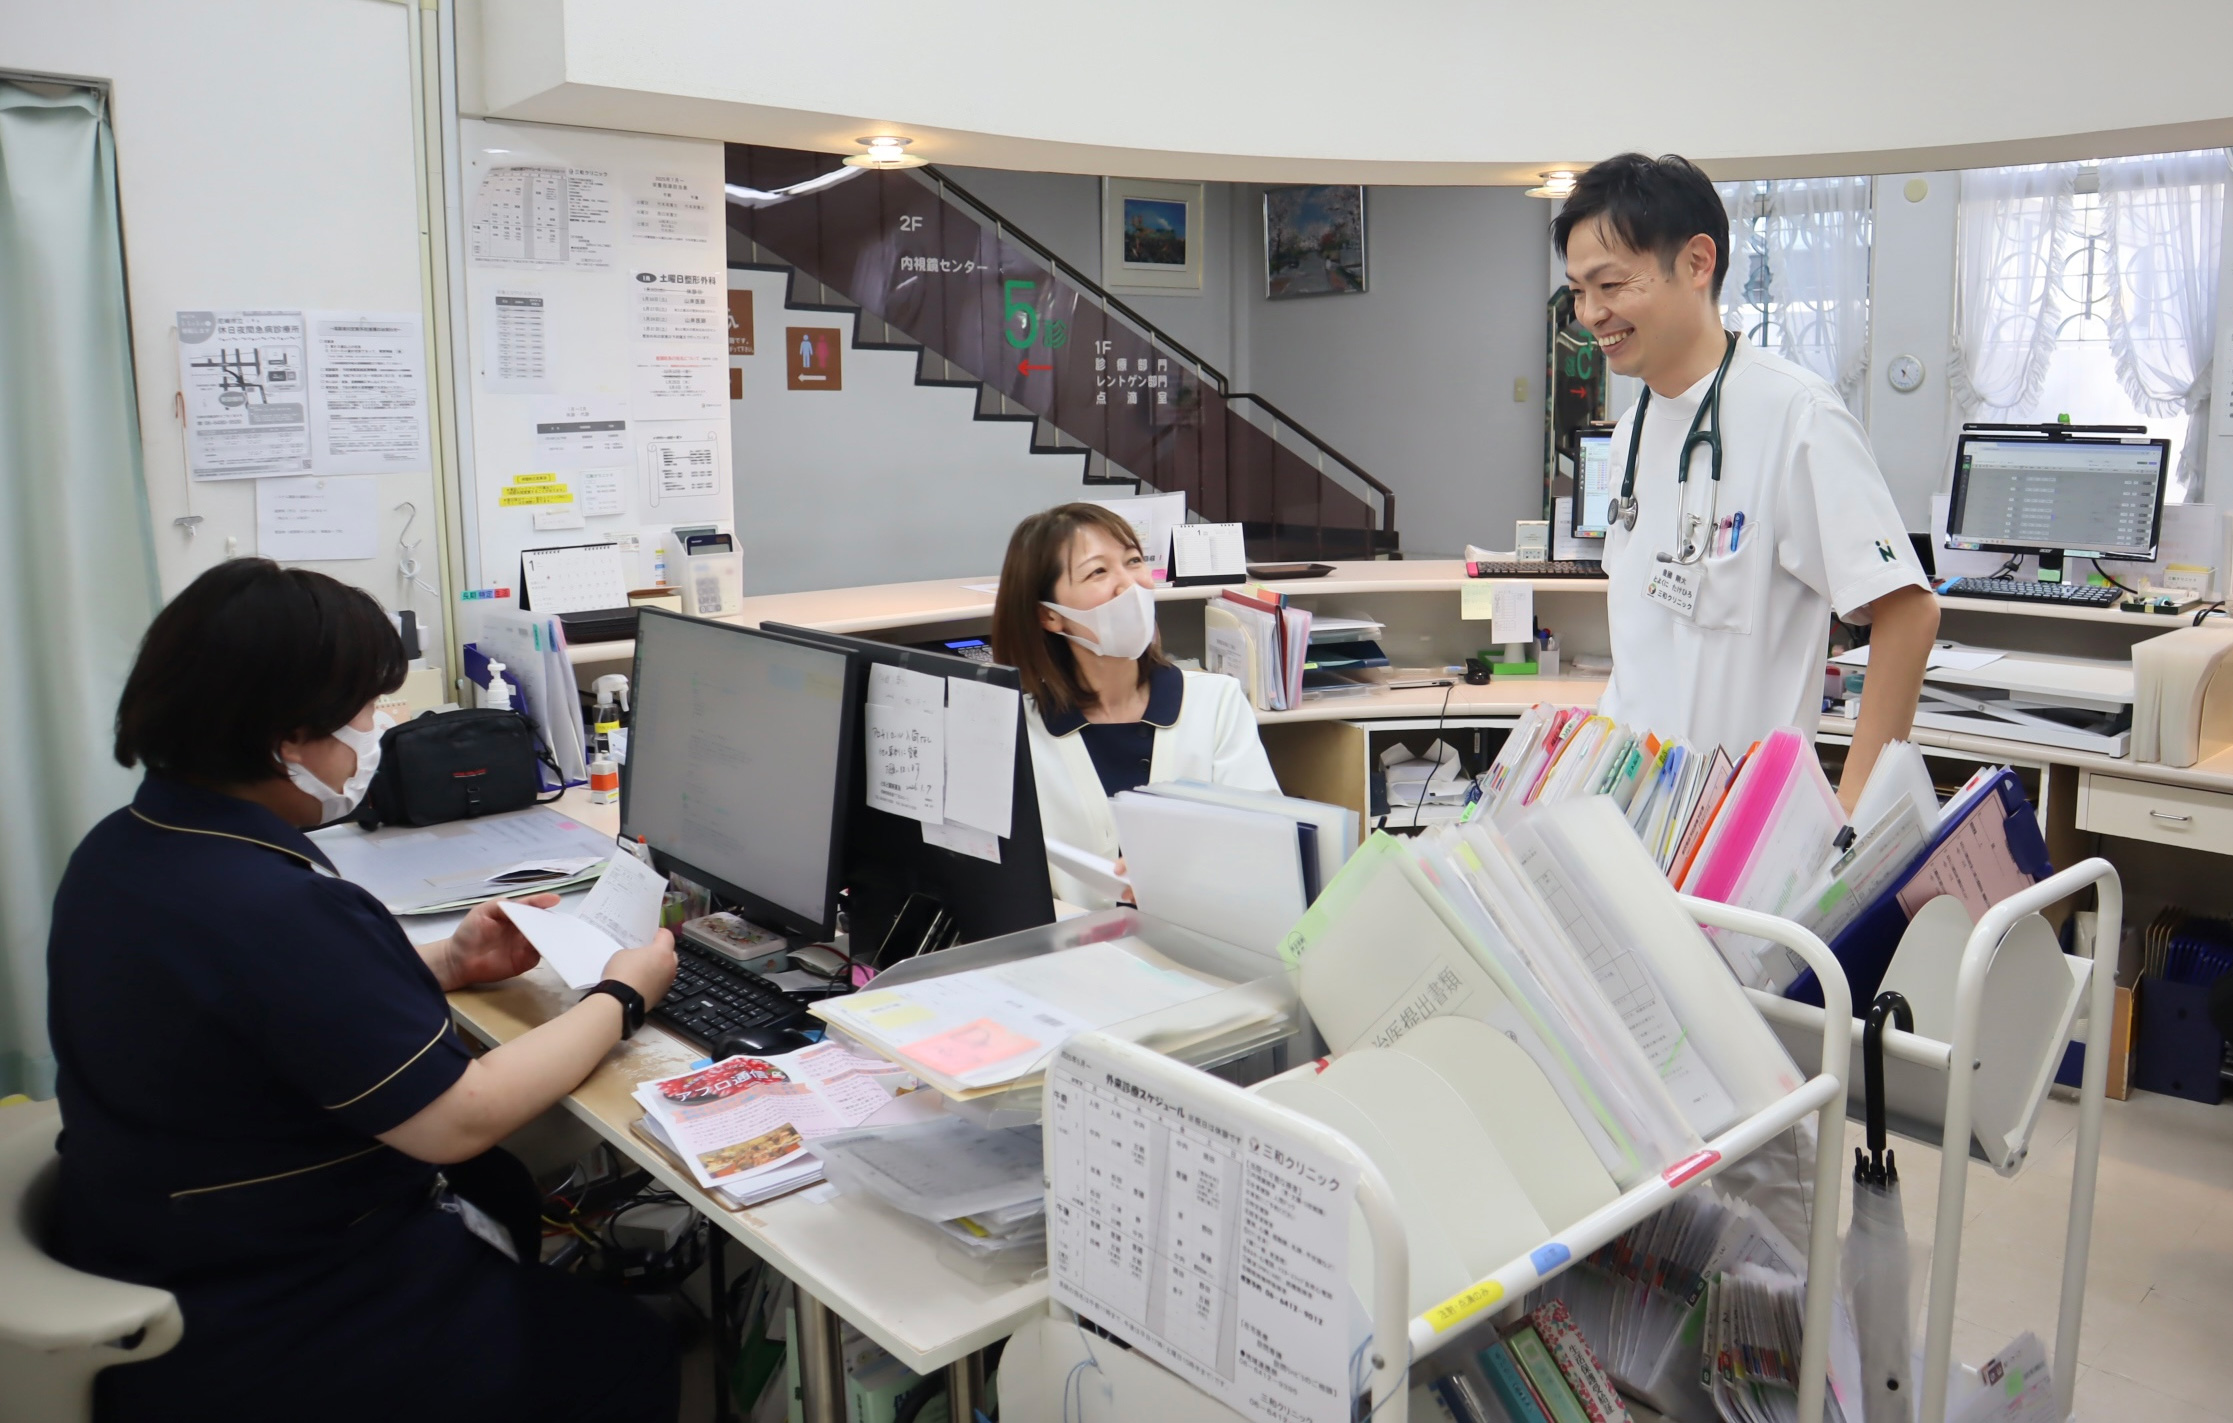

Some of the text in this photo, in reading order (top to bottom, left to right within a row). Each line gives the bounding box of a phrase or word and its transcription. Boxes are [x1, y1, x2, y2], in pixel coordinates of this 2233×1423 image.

[899, 216, 923, 232] 2F
[900, 256, 988, 274] 内視鏡センター
[660, 274, 716, 285] 土曜日整形外科
[217, 325, 300, 335] 休日夜間急病診療所
[1095, 341, 1112, 354] 1F
[1096, 375, 1167, 388] レントゲン部門
[529, 559, 535, 571] 1
[1653, 576, 1693, 599] とよくに たけひろ
[1657, 590, 1693, 610] 三和クリニック
[1106, 1073, 1185, 1119] 外来診療スケジュール
[1263, 1144, 1340, 1192] 三和クリニック
